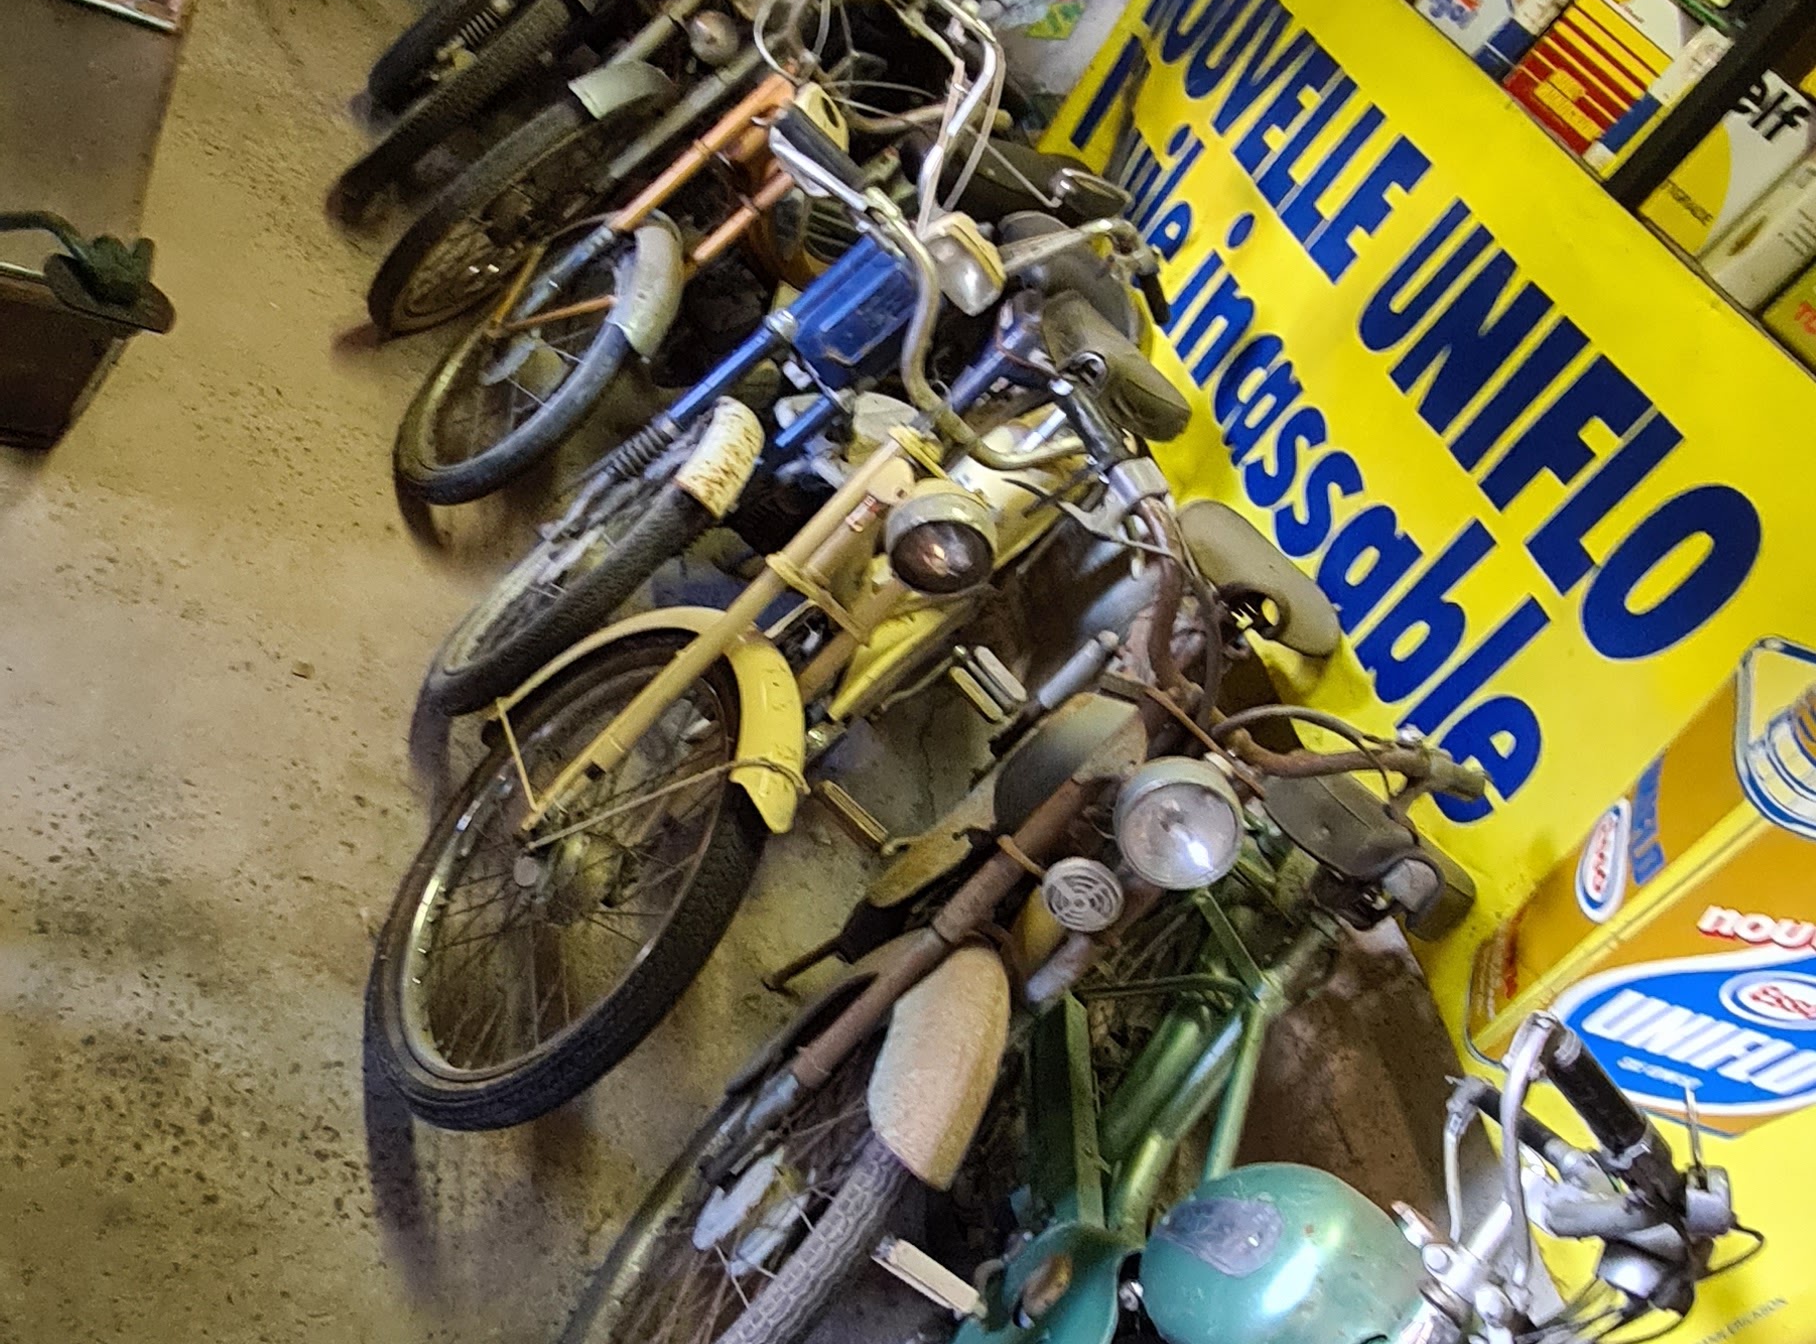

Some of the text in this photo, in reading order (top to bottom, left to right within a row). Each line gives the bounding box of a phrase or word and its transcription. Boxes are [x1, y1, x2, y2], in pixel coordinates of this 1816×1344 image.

[1732, 80, 1811, 143] elf
[1163, 212, 1543, 825] incassable
[1356, 196, 1762, 660] UNIFLO
[1696, 904, 1816, 950] nou
